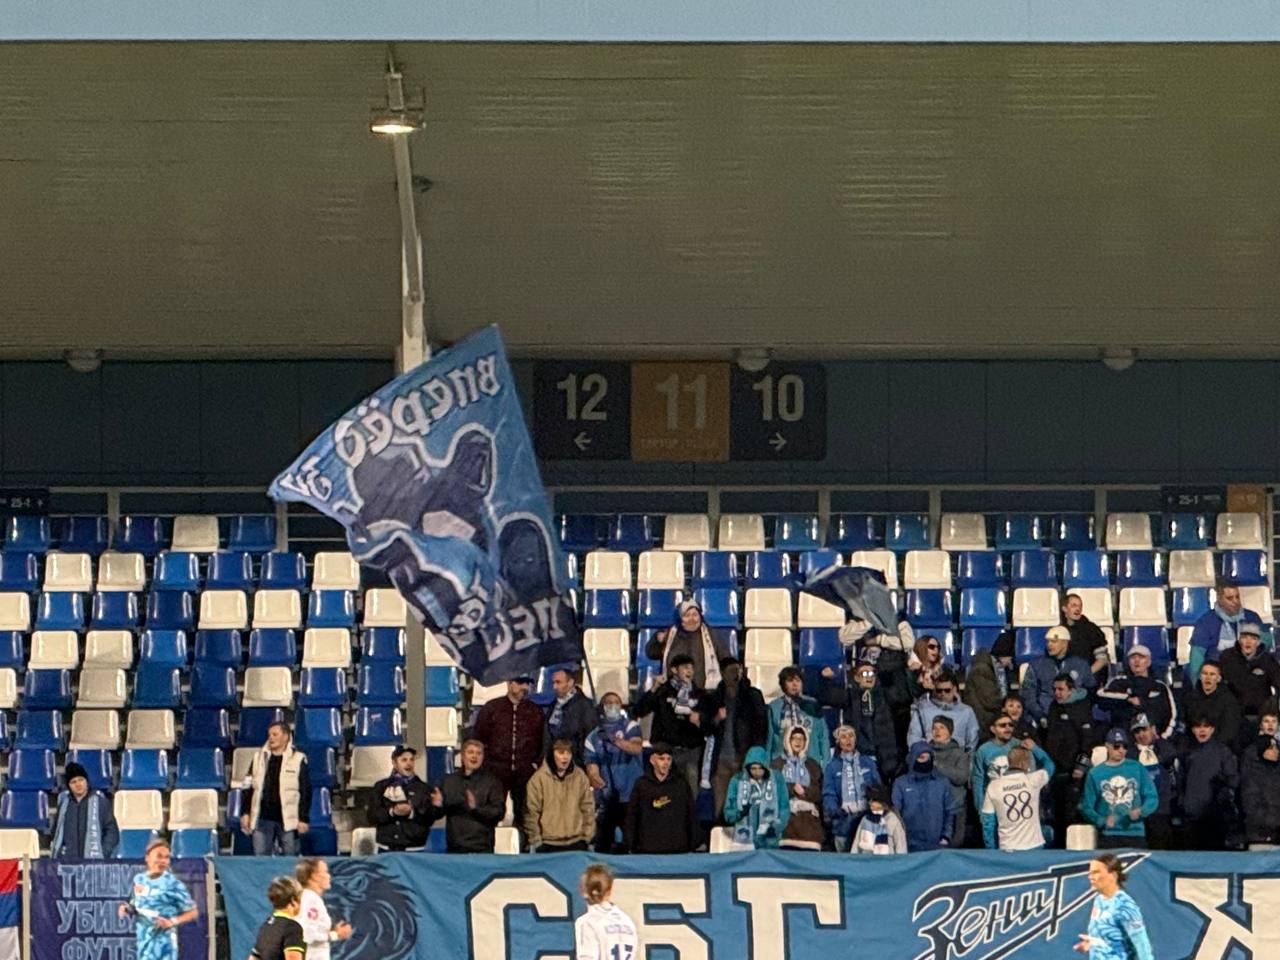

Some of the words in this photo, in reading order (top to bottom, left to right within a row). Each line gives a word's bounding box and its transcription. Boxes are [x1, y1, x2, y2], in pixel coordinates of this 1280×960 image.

[557, 373, 608, 421] 12
[656, 373, 707, 431] 11
[752, 373, 804, 421] 10
[1003, 790, 1033, 823] 88
